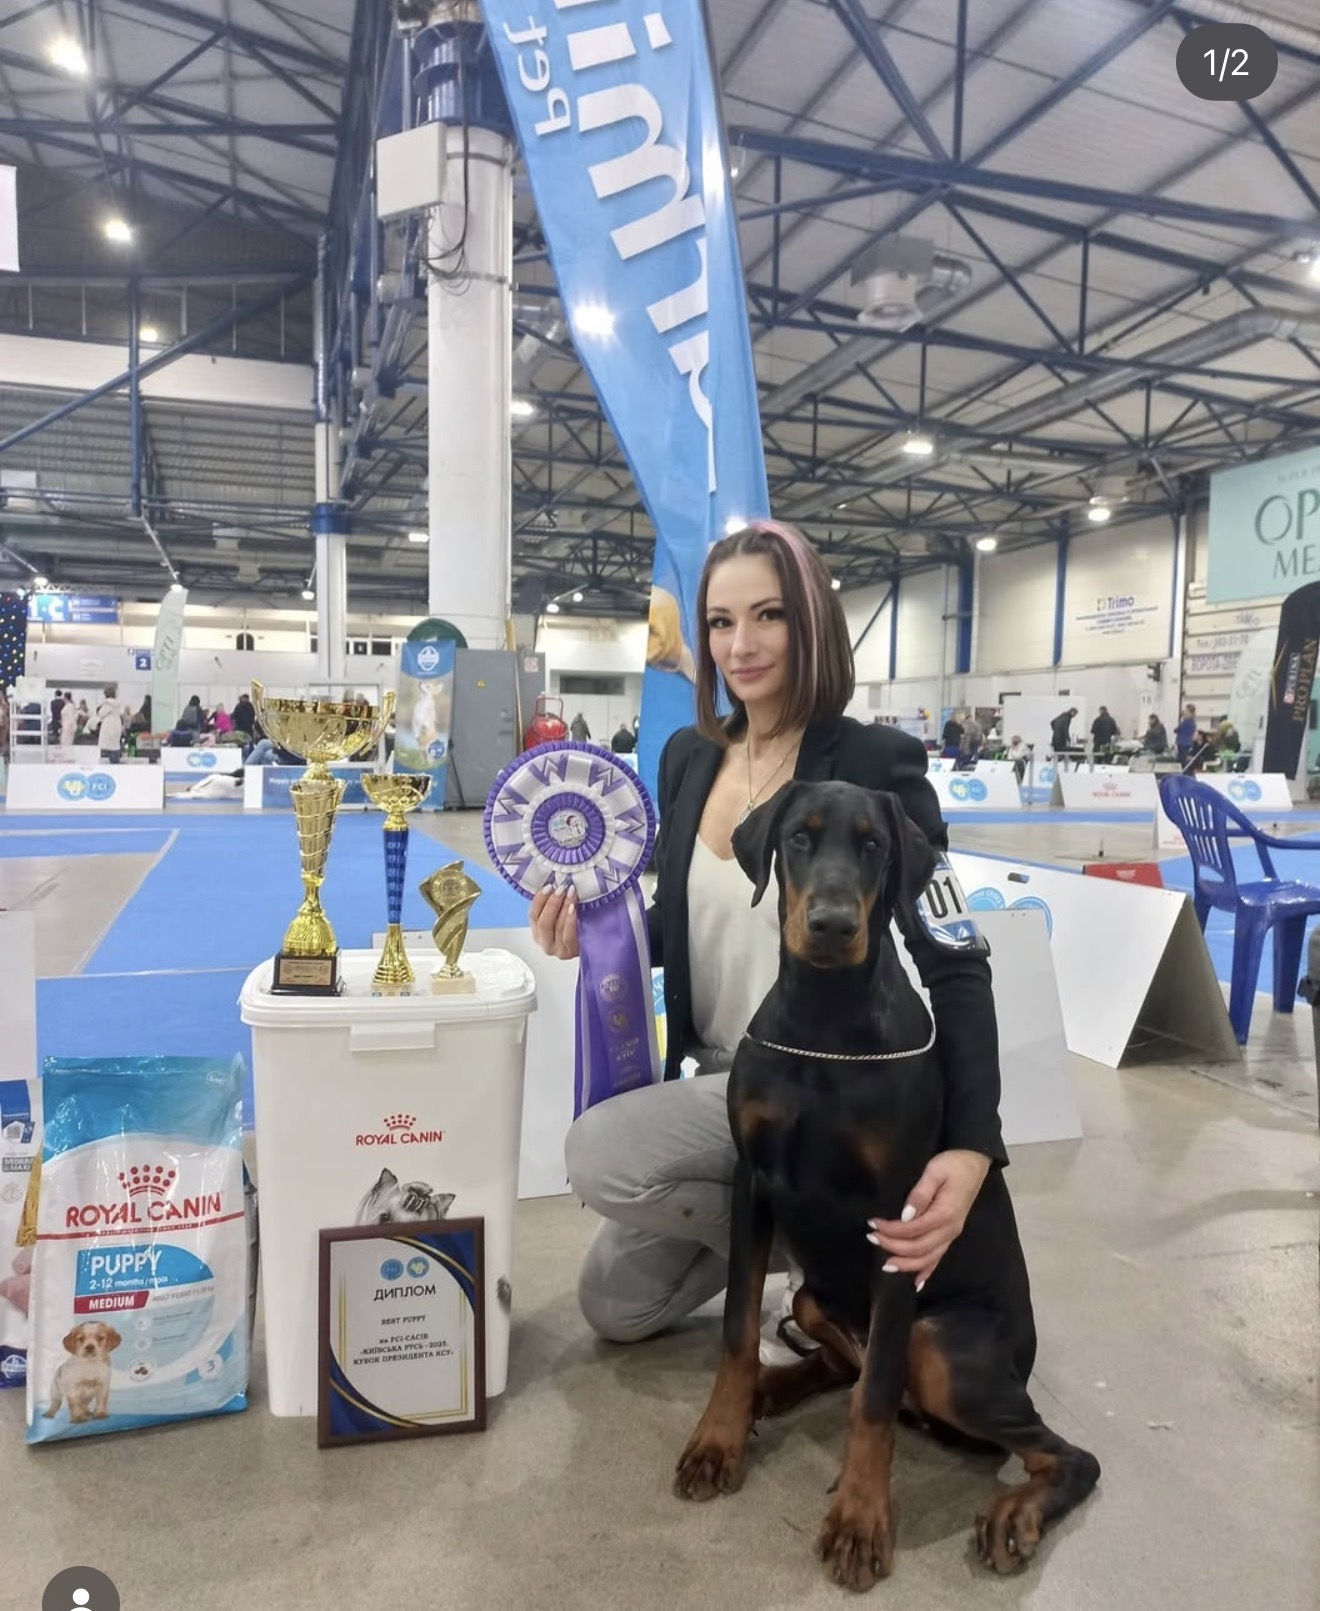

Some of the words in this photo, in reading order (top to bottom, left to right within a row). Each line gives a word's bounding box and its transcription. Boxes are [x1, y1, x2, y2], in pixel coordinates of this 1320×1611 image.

[1273, 544, 1320, 579] ME
[1107, 595, 1135, 609] Trimo
[139, 658, 147, 668] 2
[91, 783, 107, 792] FCI
[355, 1133, 397, 1147] ROYAL
[400, 1130, 443, 1144] CANIN
[66, 1201, 142, 1228] ROYAL
[147, 1191, 221, 1222] CANIN
[90, 1250, 162, 1277] PUPPY
[89, 1277, 113, 1290] 2-12
[373, 1284, 436, 1301] ДИПЛОМ
[89, 1295, 135, 1310] MEDIUM
[381, 1316, 400, 1325] BEST
[403, 1314, 426, 1324] PUPPY
[353, 1356, 380, 1365] КУБОК
